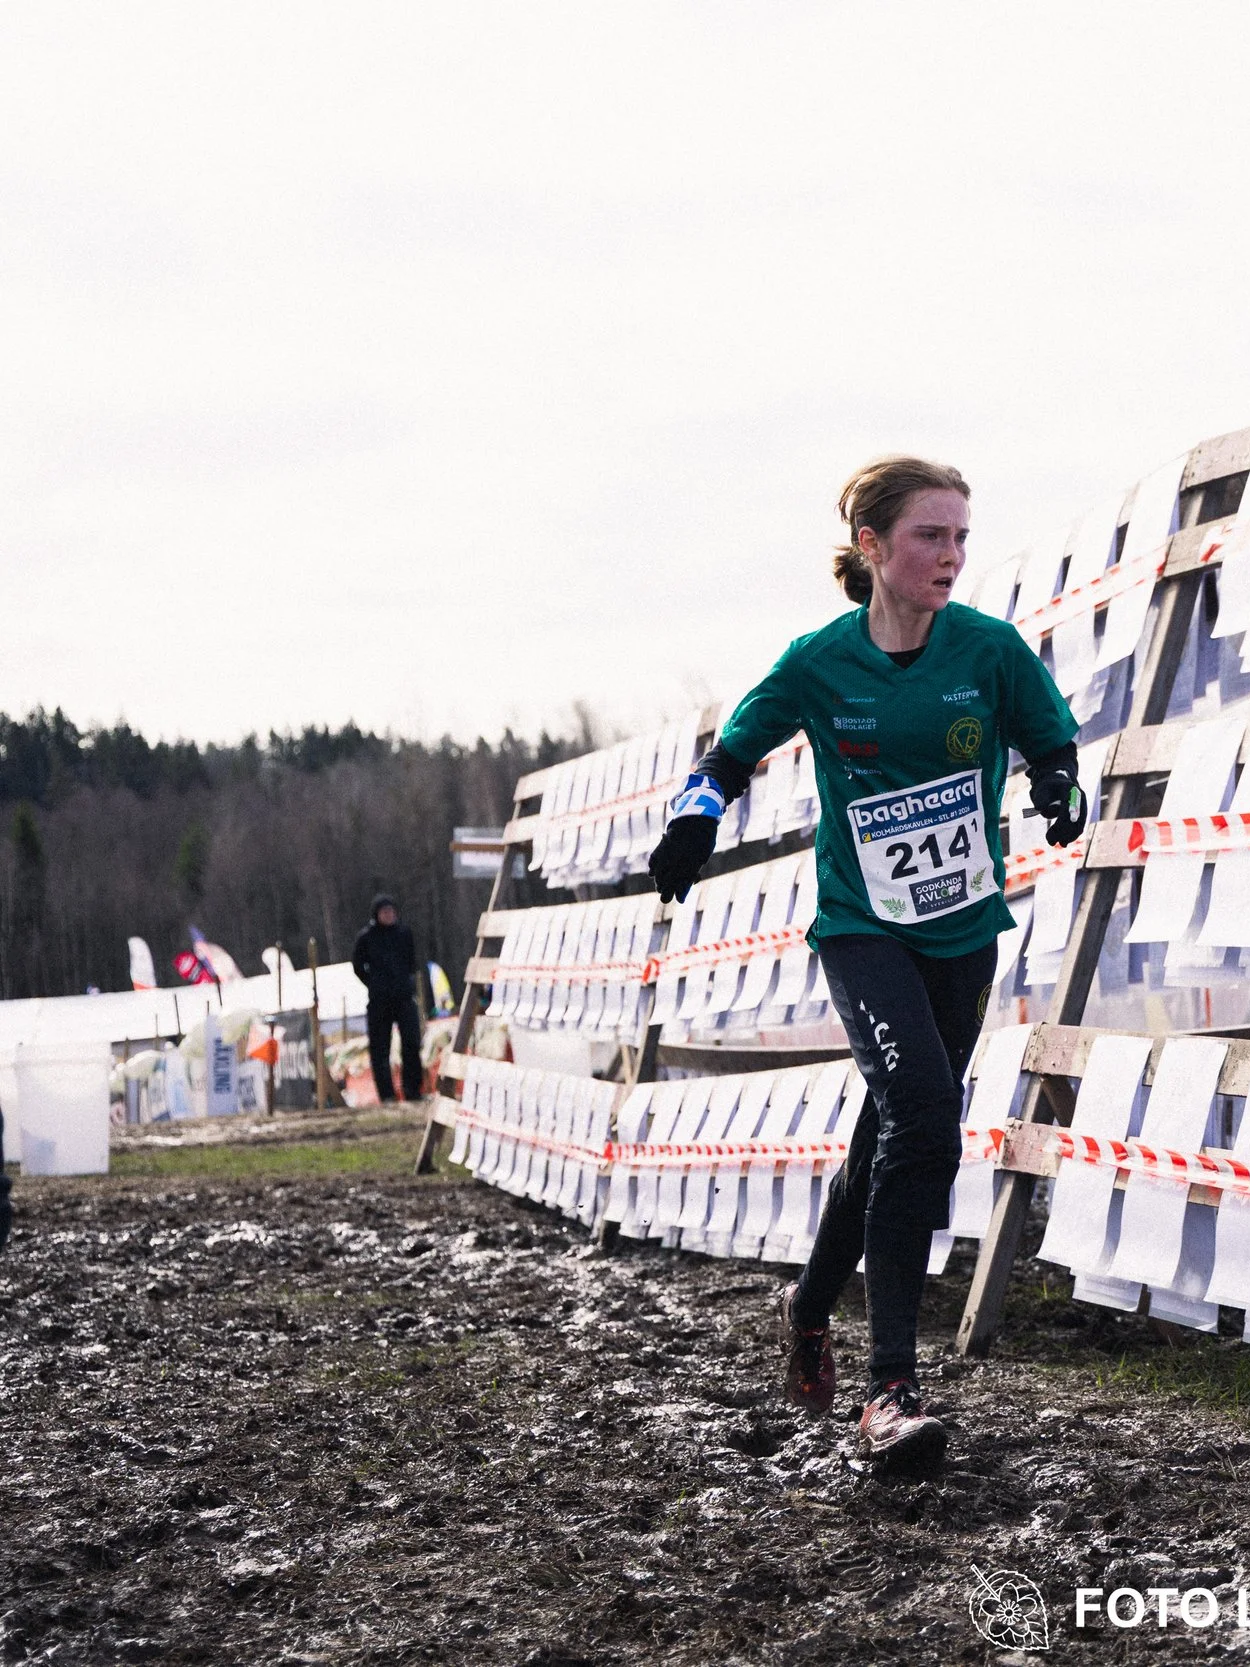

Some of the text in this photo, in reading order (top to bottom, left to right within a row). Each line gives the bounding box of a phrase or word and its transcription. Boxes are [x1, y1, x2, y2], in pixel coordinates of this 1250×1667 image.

[855, 780, 975, 828] bagheera
[871, 818, 934, 839] KOLMÅRDSKAVLEN
[938, 814, 950, 822] STL
[958, 806, 970, 817] 2026
[971, 818, 978, 833] 1
[884, 823, 971, 881] 214
[916, 876, 962, 894] GODKÄNDA
[919, 883, 962, 905] AVLOPP
